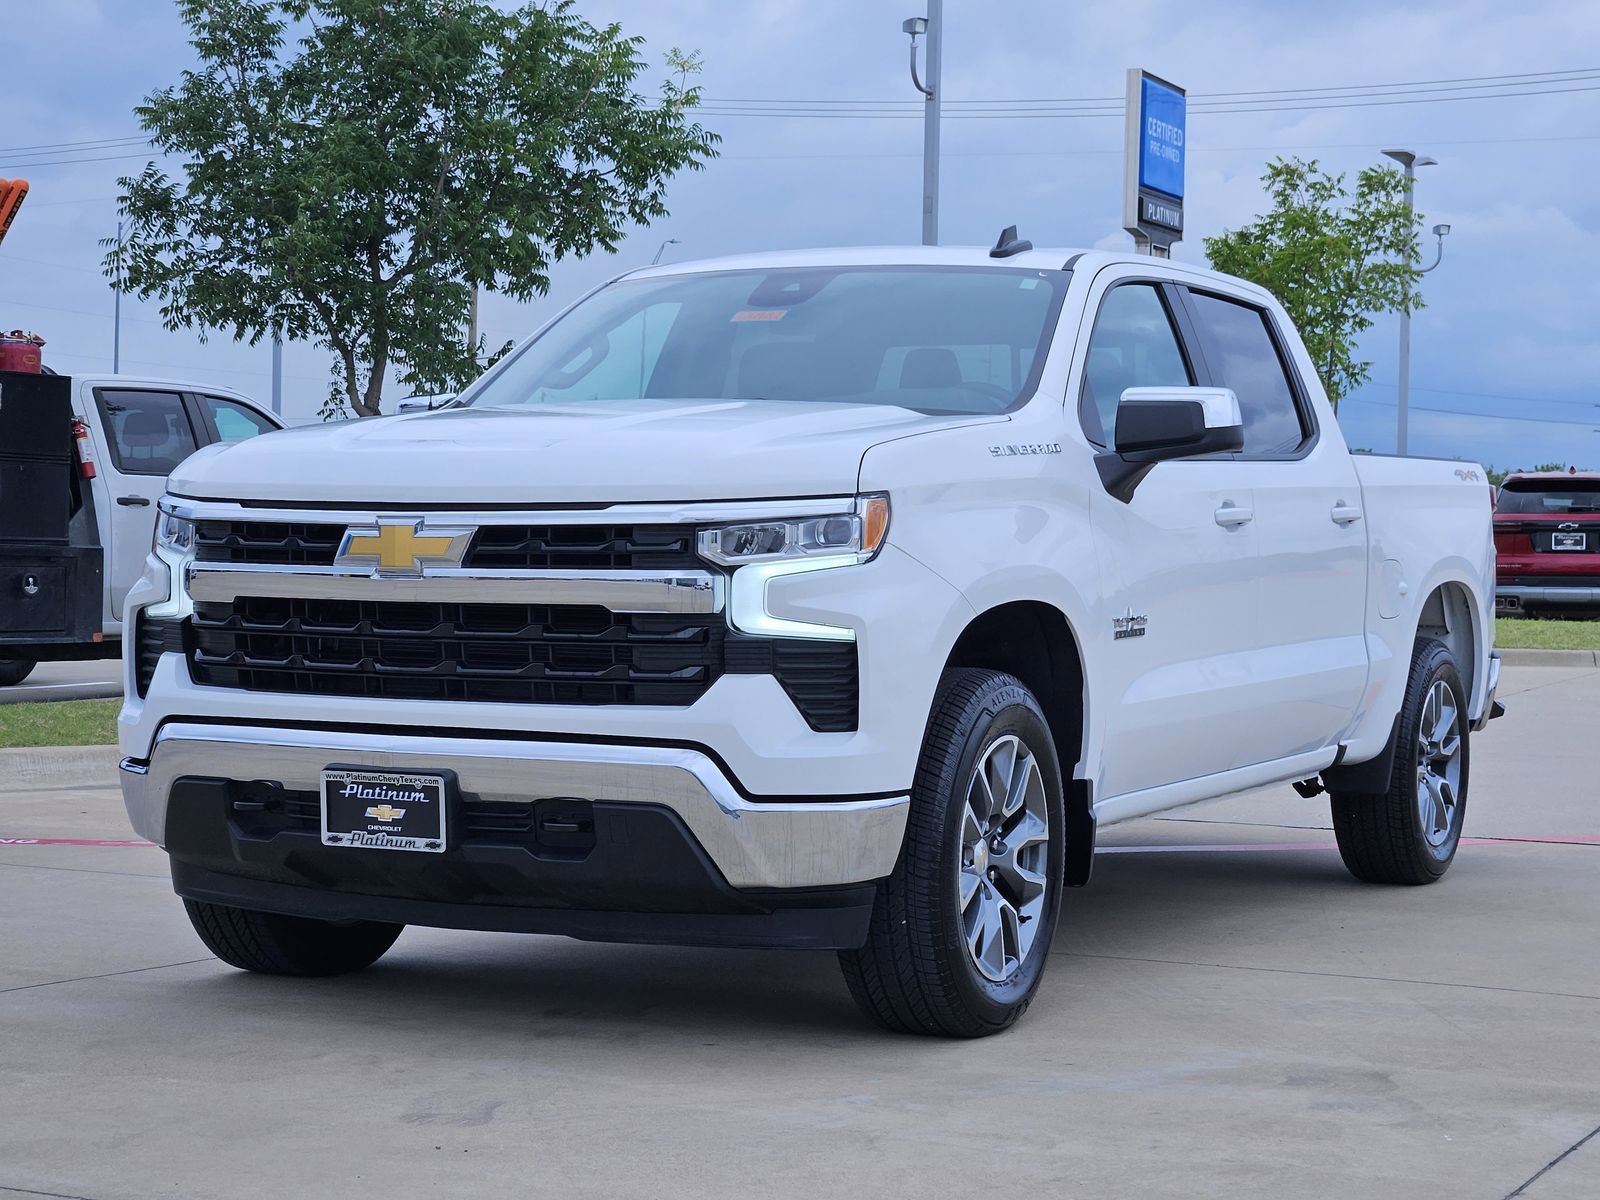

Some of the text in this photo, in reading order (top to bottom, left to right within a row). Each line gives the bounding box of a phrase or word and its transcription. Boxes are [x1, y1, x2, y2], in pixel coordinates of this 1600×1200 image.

[1147, 117, 1183, 146] CERTIFIED
[1149, 140, 1180, 163] PRE-OWNED
[1148, 203, 1180, 226] PLATINUM
[988, 443, 1062, 457] SILVERADO
[991, 688, 1022, 709] ALENZA
[325, 772, 440, 785] www.PlatinumChevyTexas.com
[339, 783, 430, 802] Platinum
[367, 824, 402, 832] CHEVROLET
[346, 831, 421, 848] Platinum
